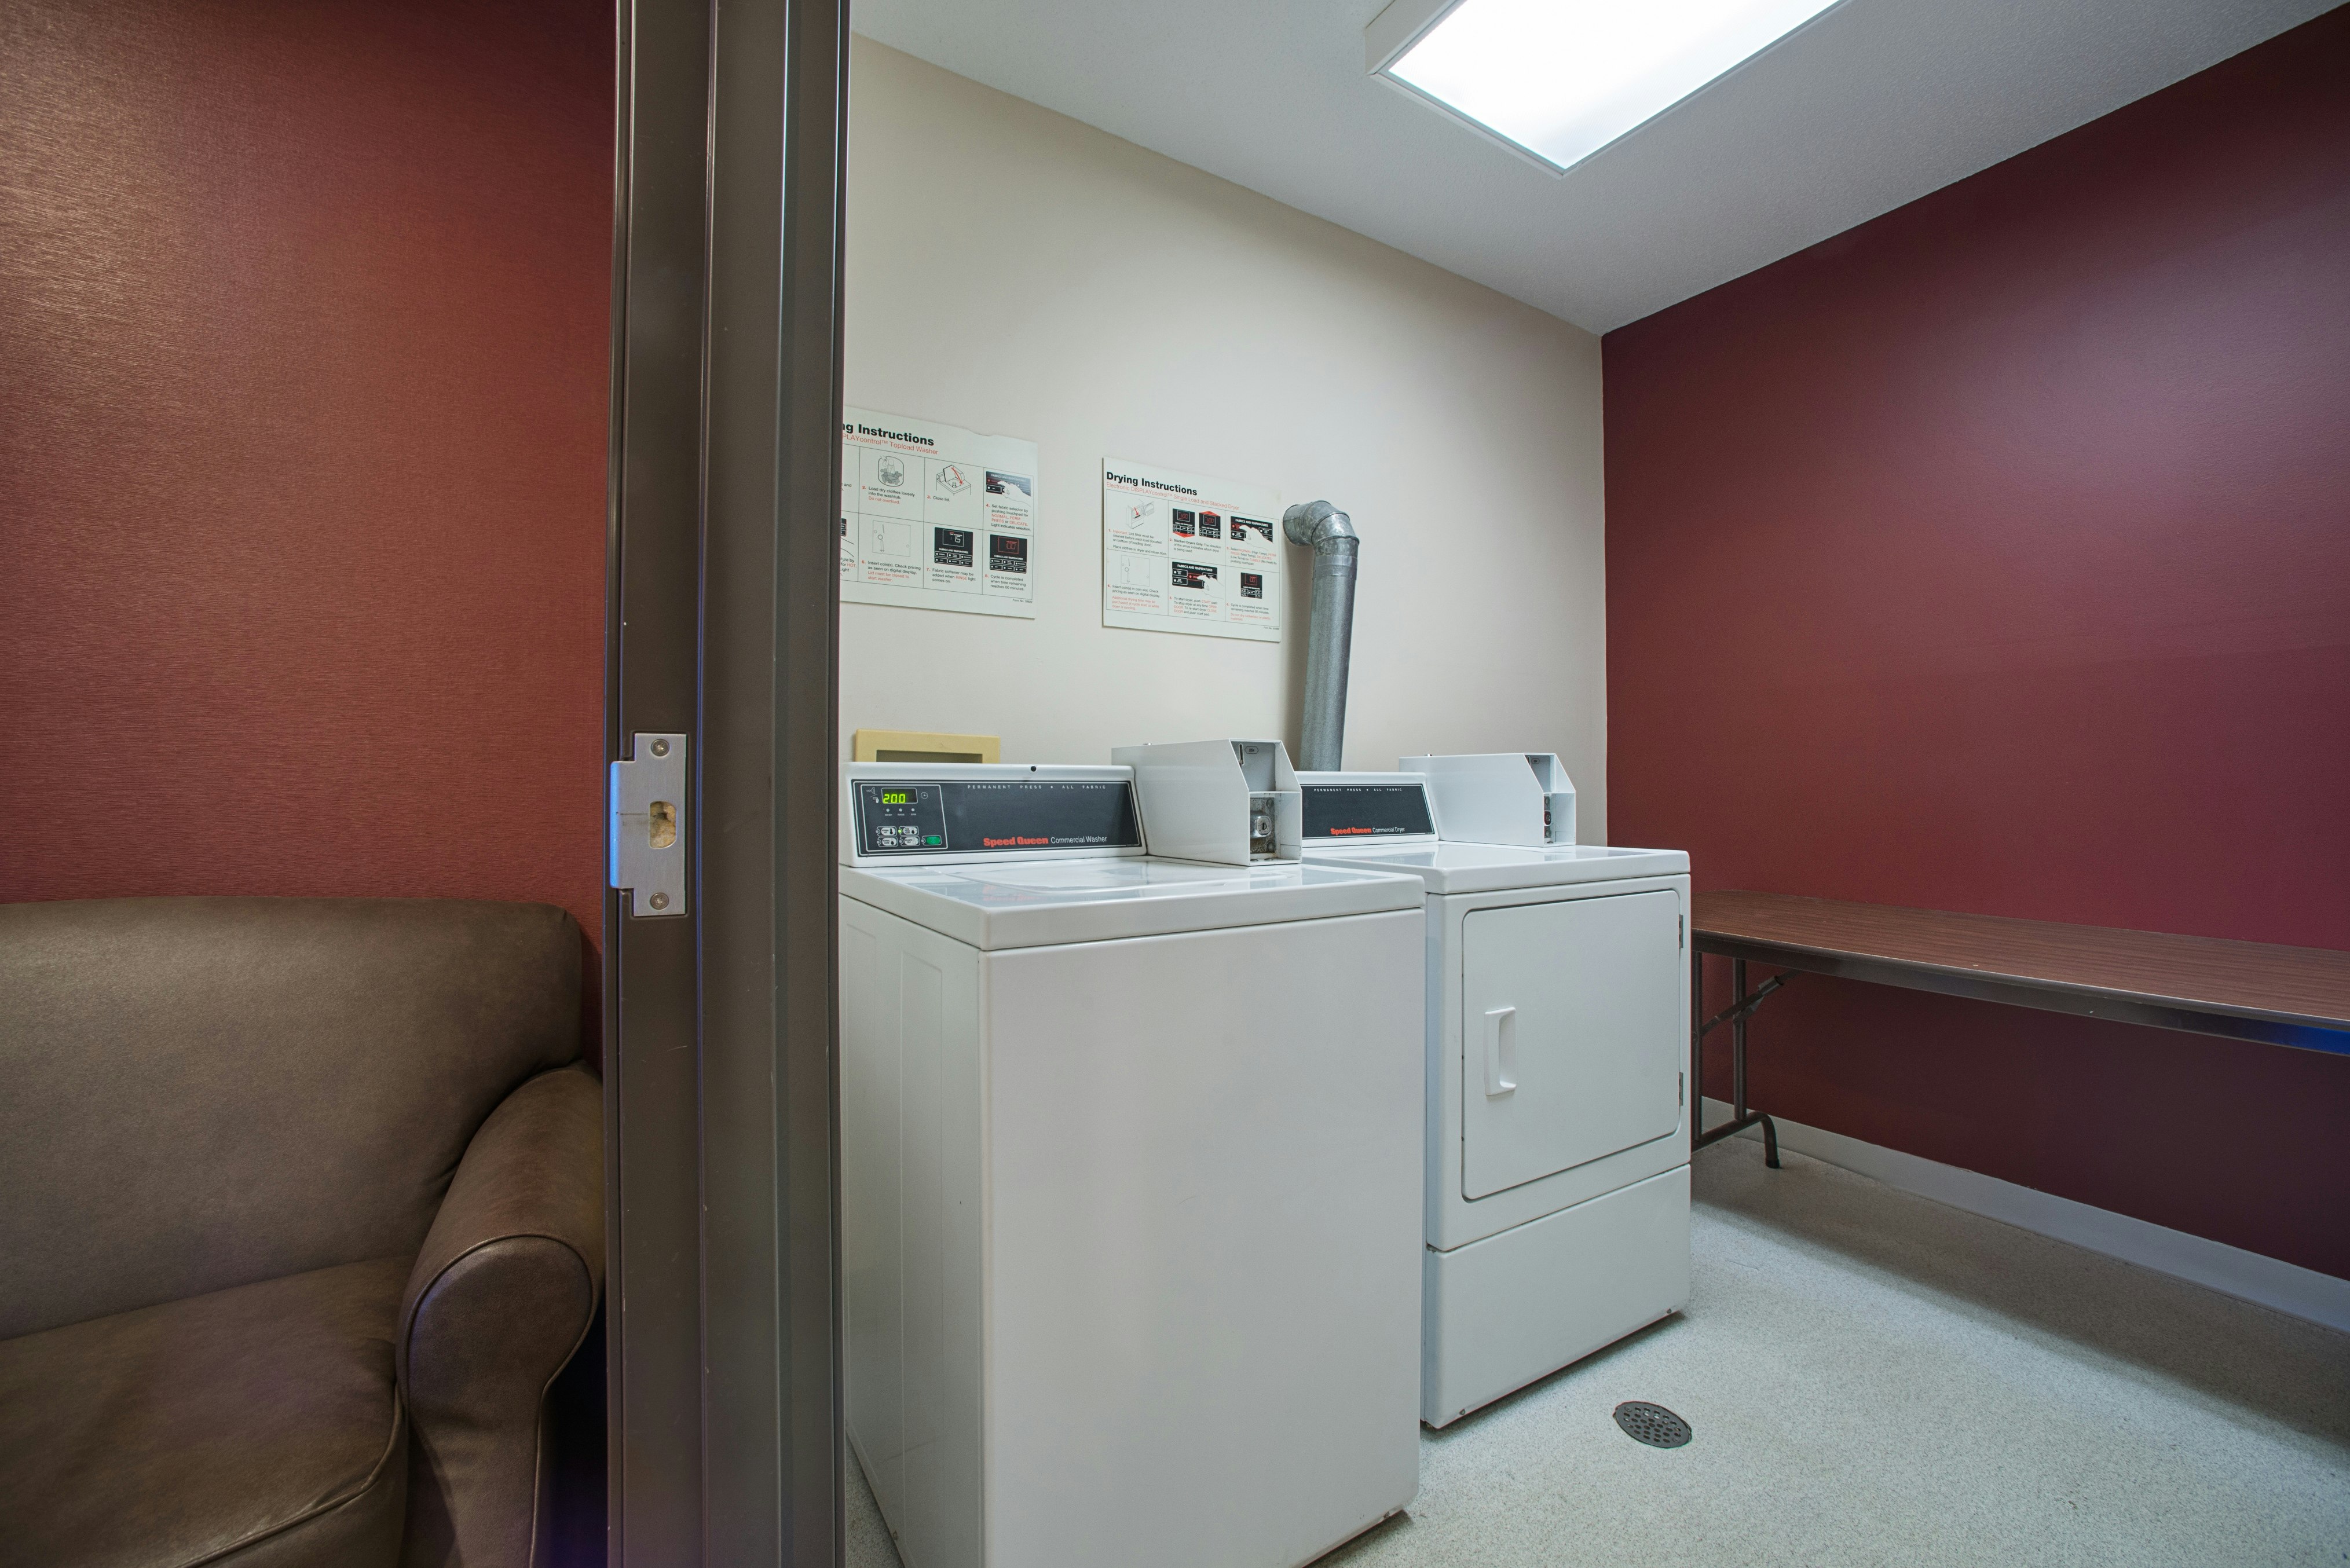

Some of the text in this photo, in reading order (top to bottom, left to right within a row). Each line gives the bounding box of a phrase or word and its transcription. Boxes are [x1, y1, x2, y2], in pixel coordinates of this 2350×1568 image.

[859, 424, 934, 446] Instructions
[890, 442, 914, 450] Topload
[916, 446, 938, 455] Washer
[1107, 472, 1198, 496] Drying Instructions
[1107, 482, 1130, 491] Electronic
[1210, 501, 1227, 509] Stacked
[883, 794, 906, 804] 200
[1330, 827, 1350, 836] Speed
[984, 837, 1016, 848] Speed
[1017, 837, 1049, 845] Queen
